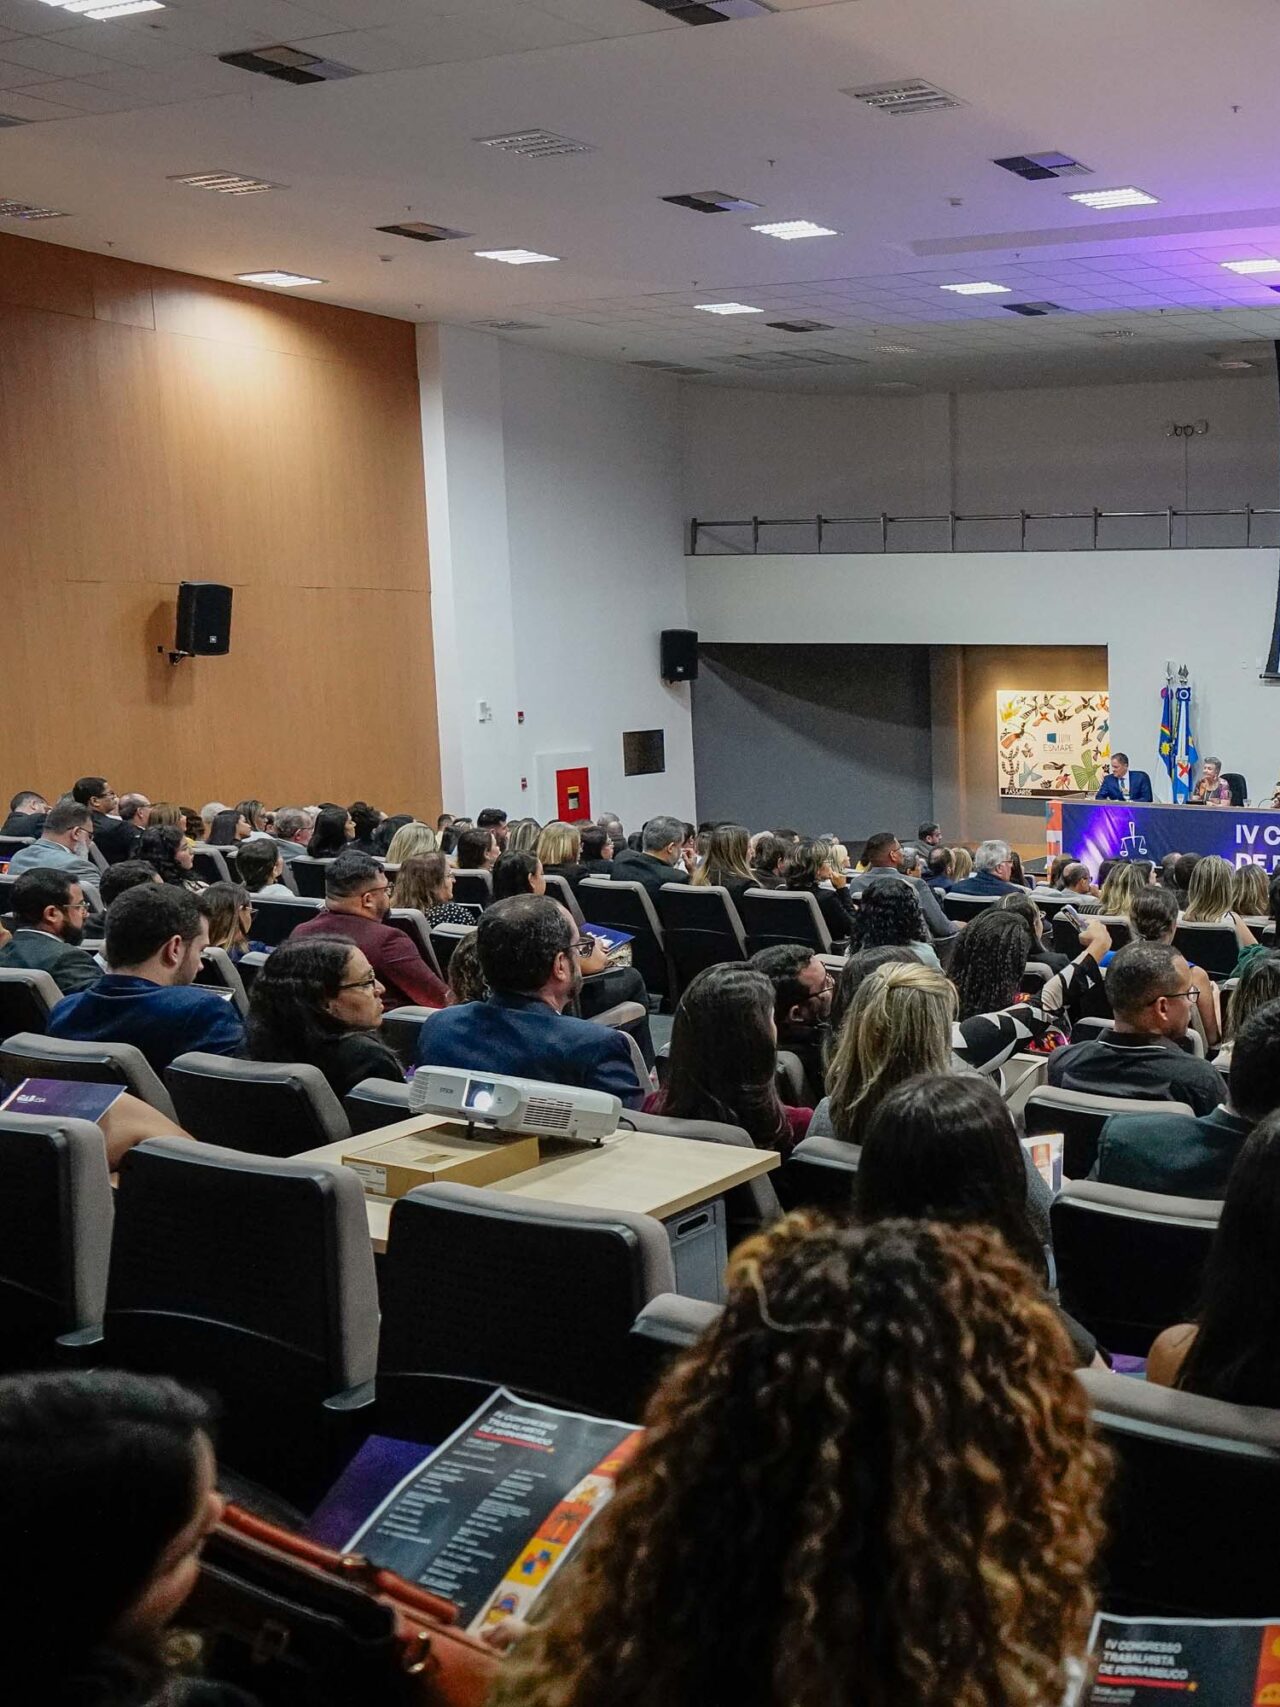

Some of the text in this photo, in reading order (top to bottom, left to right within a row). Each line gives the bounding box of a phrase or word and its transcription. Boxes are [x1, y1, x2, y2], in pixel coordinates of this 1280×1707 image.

[1043, 744, 1074, 752] ESMAPE
[1236, 824, 1259, 845] IV
[1235, 853, 1267, 876] DE
[1118, 1640, 1182, 1654] CONGRESSO
[1103, 1650, 1175, 1667] TRABALHISTA
[1115, 1665, 1189, 1680] PERNAMBUCO
